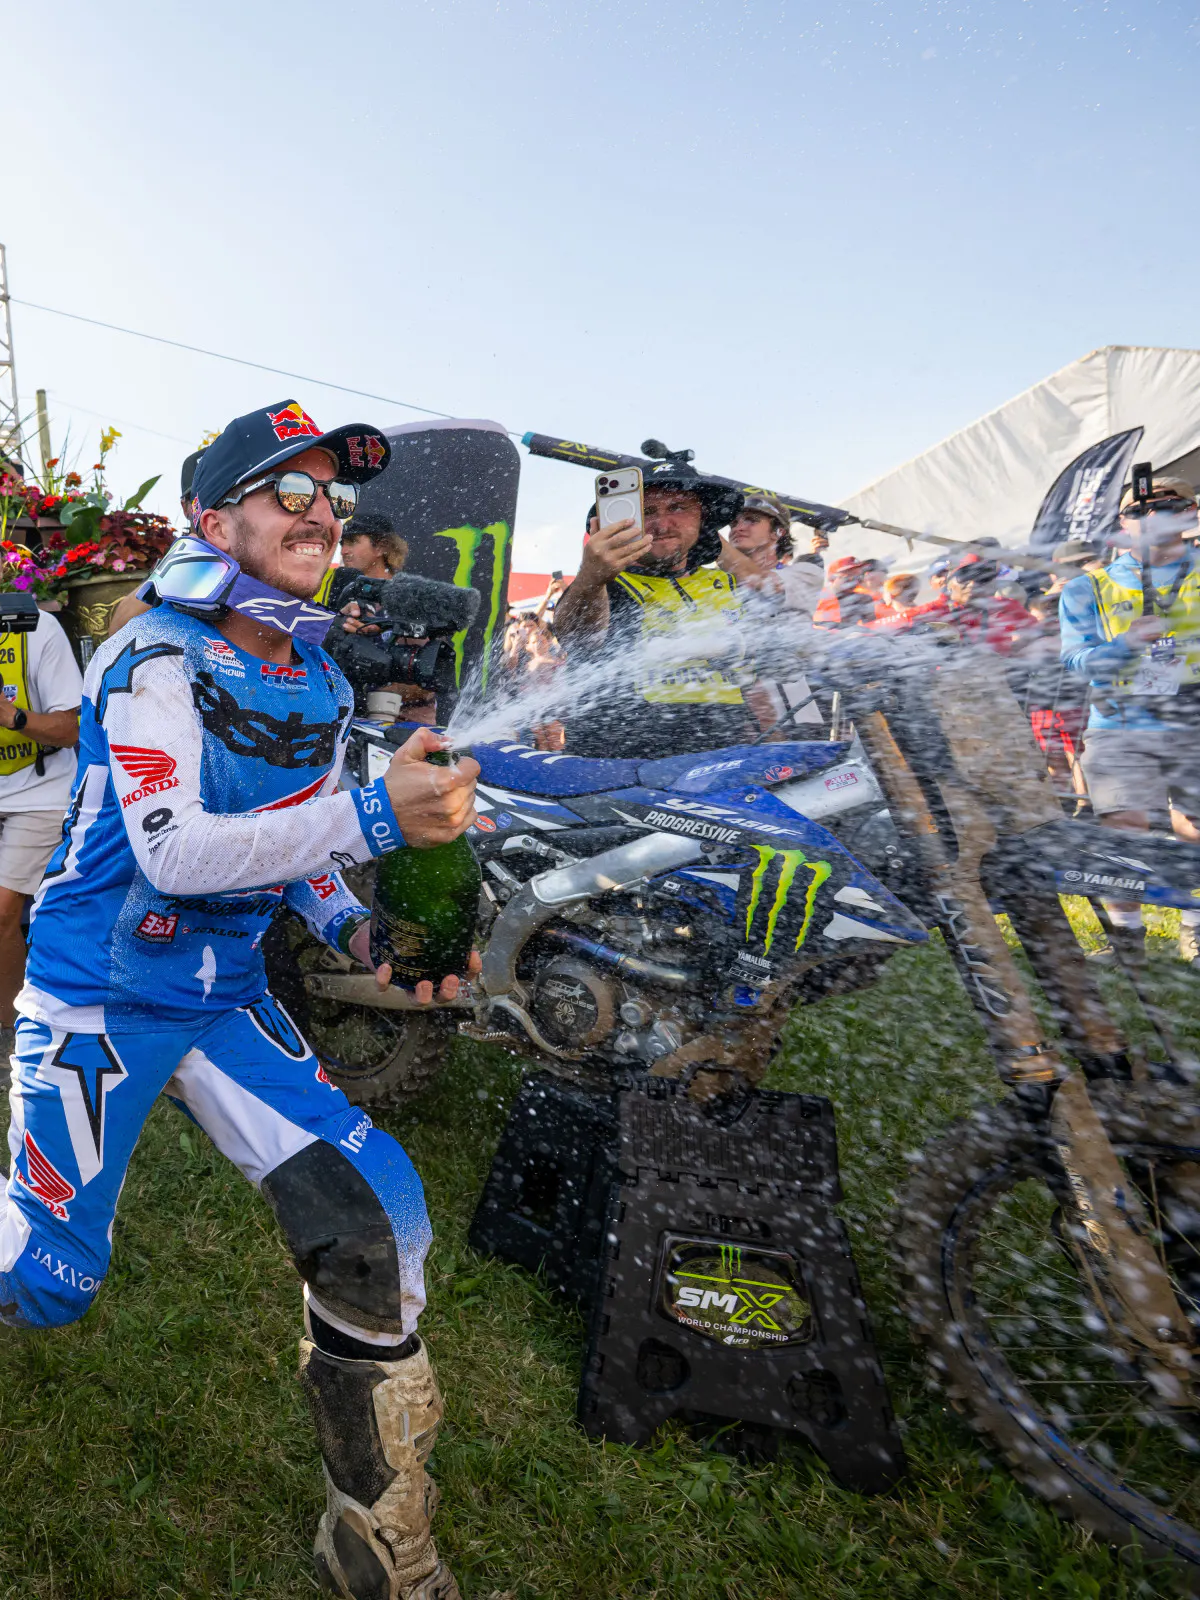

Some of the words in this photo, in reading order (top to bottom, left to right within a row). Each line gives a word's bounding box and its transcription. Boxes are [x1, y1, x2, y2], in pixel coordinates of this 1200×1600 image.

[273, 425, 308, 442] Red
[346, 436, 362, 452] Red
[1111, 599, 1134, 615] 20
[0, 648, 15, 664] 26
[260, 664, 308, 687] HRC
[686, 759, 744, 780] GYTR
[765, 764, 783, 781] VP
[121, 776, 180, 809] HONDA
[643, 810, 742, 845] PROGRESSIVE
[1083, 872, 1146, 891] YAMAHA
[737, 950, 772, 970] YAMALUBE
[676, 1286, 785, 1331] SMX
[678, 1316, 712, 1328] WORLD
[713, 1322, 789, 1343] CHAMPIONSHIP
